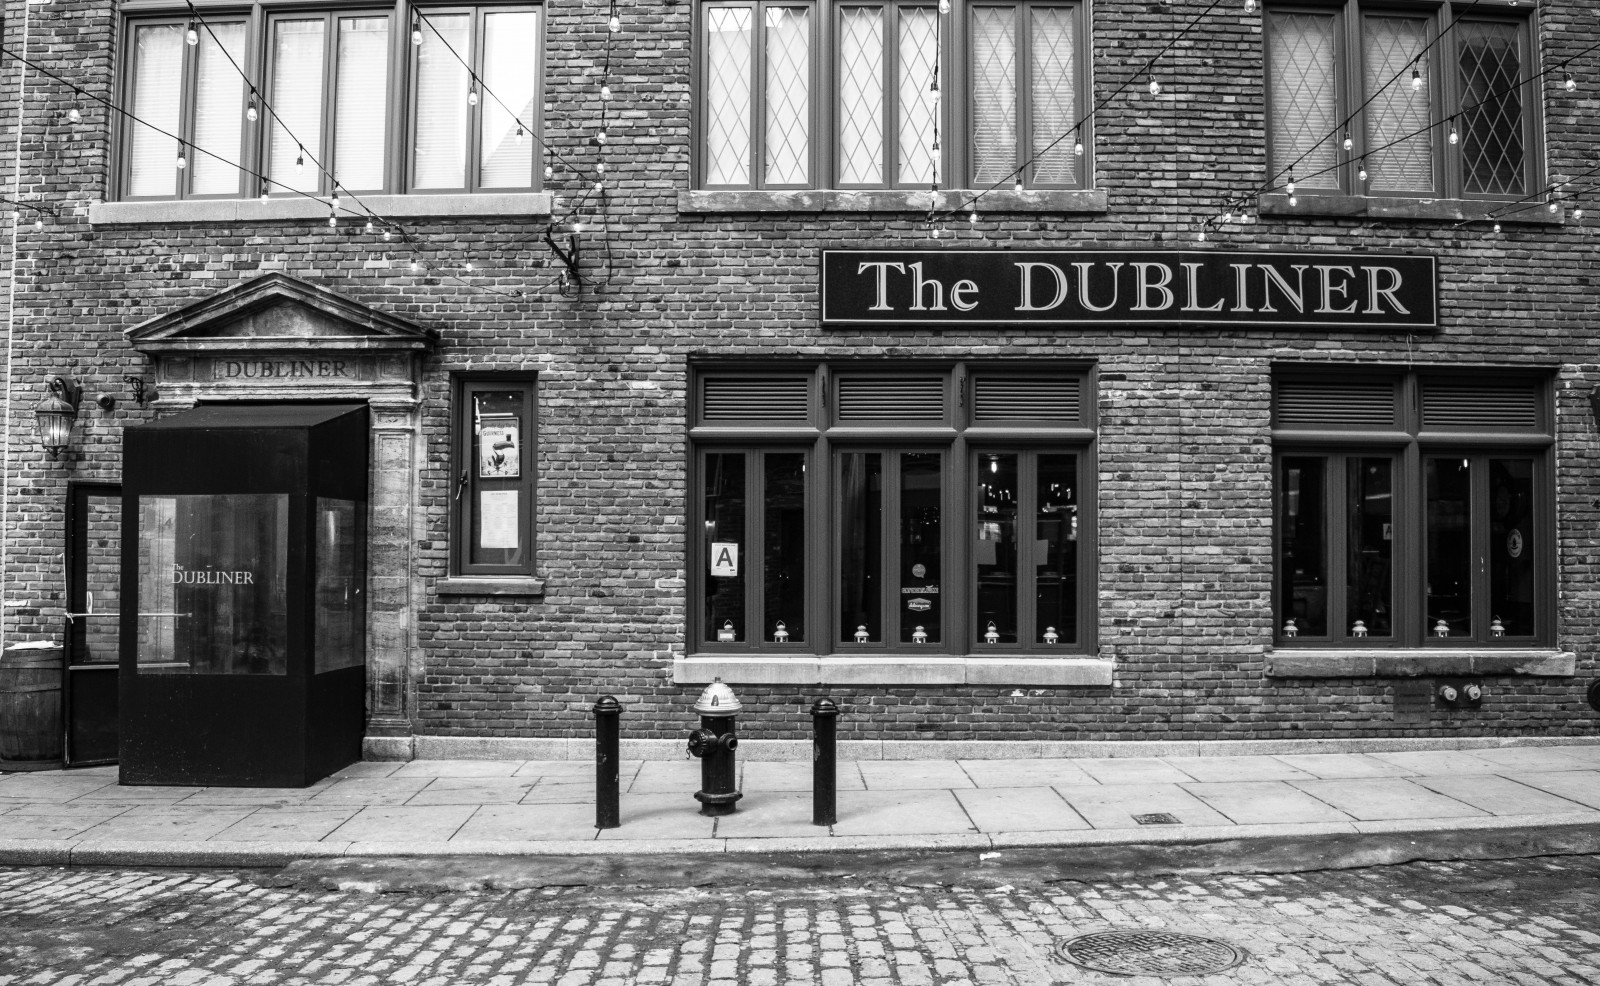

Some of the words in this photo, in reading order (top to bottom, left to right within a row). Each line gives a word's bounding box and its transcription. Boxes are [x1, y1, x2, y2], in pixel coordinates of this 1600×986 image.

[858, 262, 979, 311] The
[1014, 262, 1410, 314] DUBLINER
[225, 360, 348, 378] DUBLINER
[715, 547, 734, 567] A
[171, 563, 184, 571] The
[171, 571, 254, 585] DUBLINER
